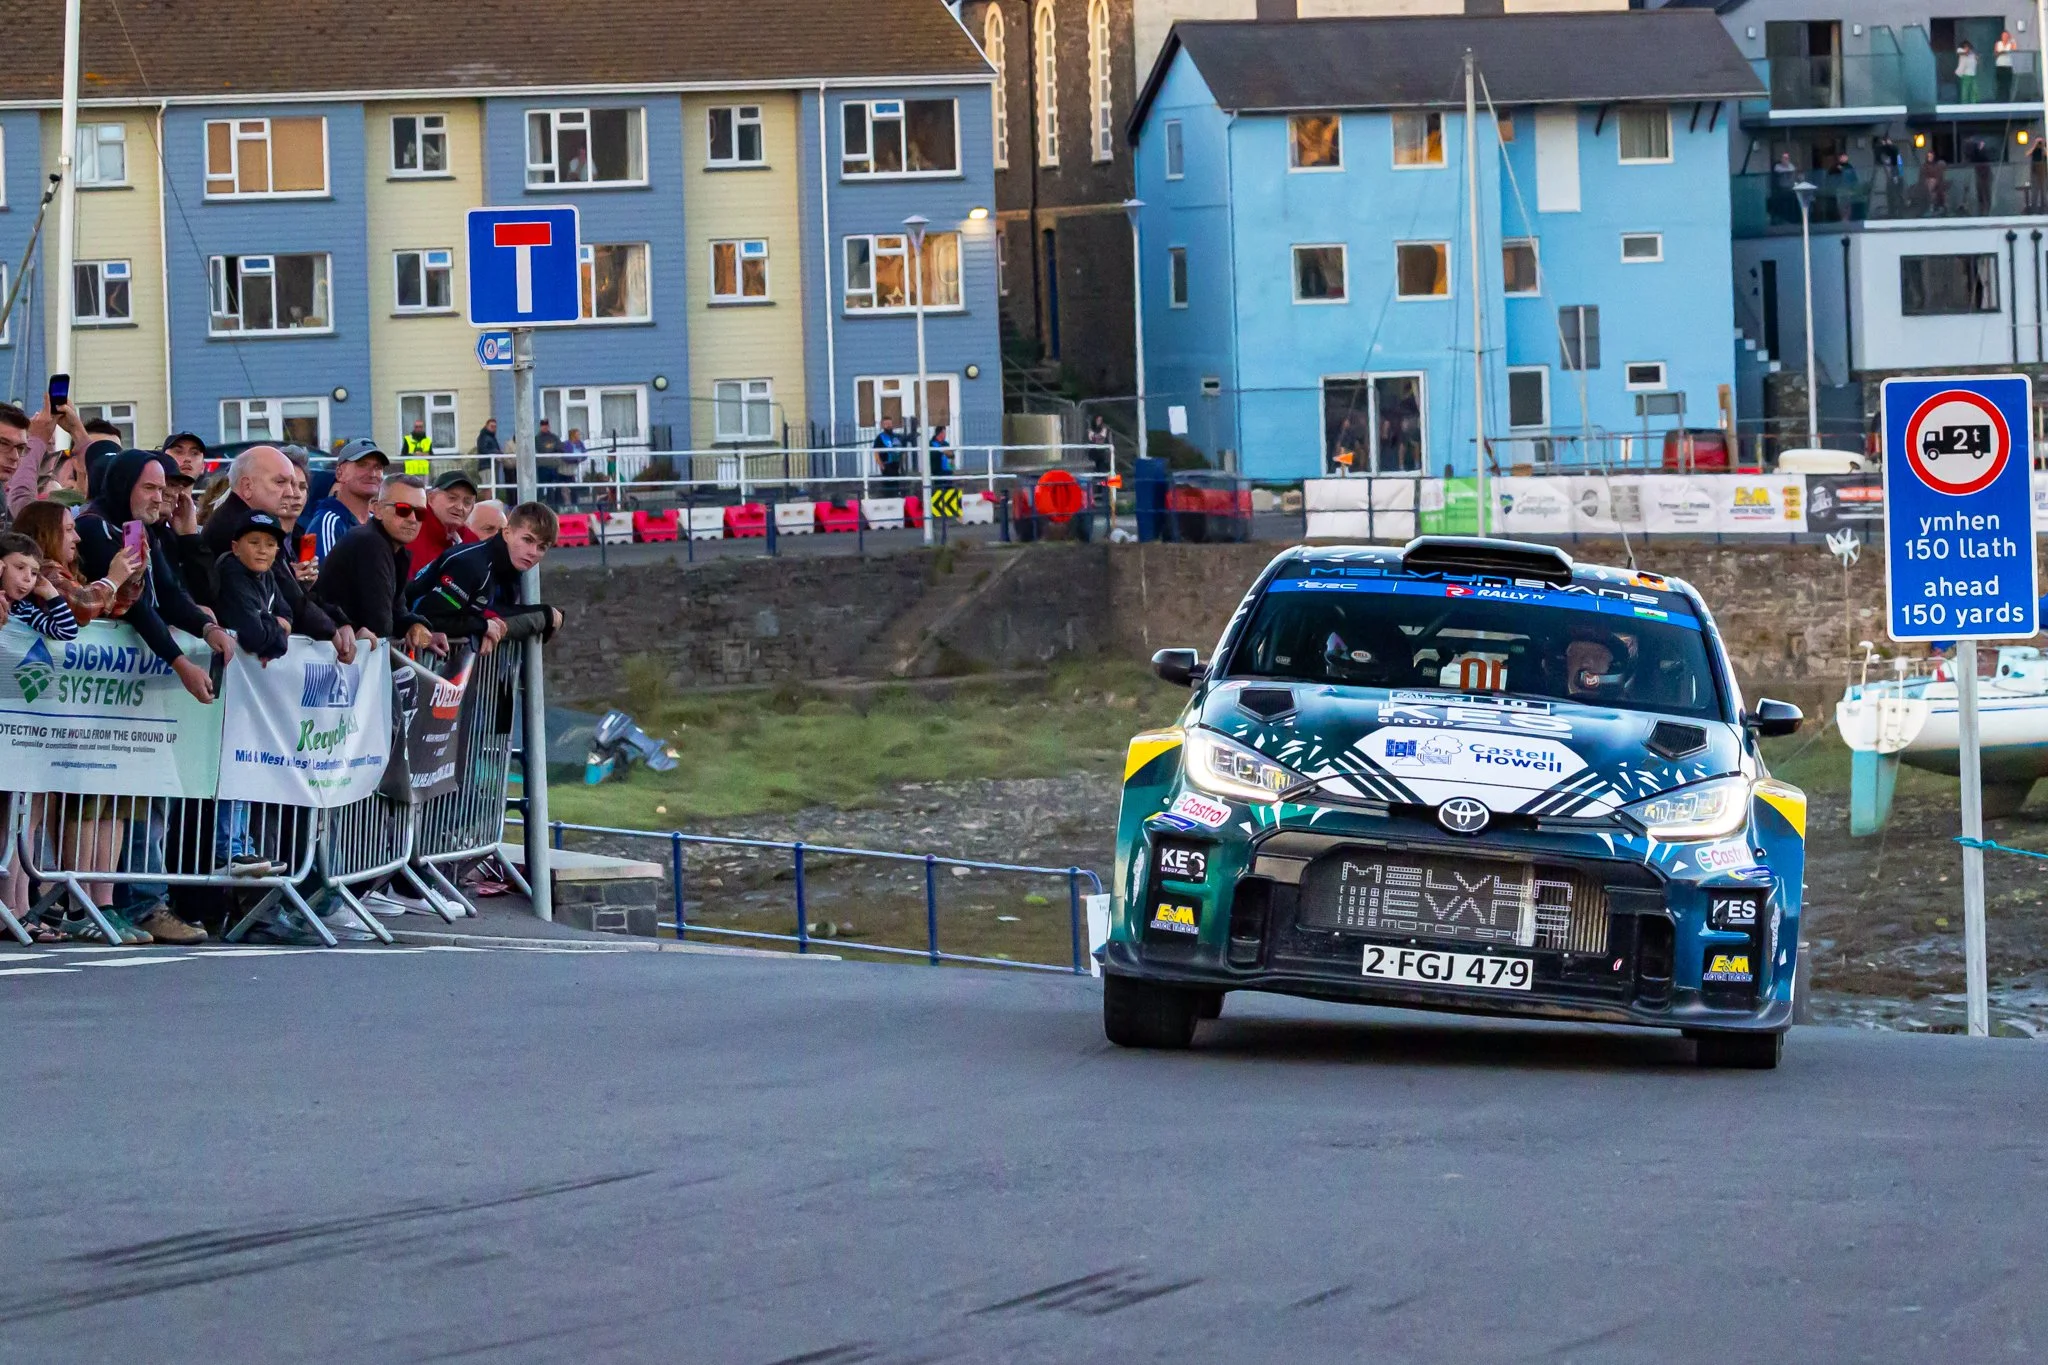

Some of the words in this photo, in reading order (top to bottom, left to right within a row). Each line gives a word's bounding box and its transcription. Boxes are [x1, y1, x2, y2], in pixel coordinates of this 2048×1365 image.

[1919, 511, 2000, 536] ymhen
[1905, 538, 1949, 560] 150
[1959, 537, 2016, 558] llath
[1477, 589, 1529, 600] RALLY
[1515, 578, 1659, 605] EVANS
[1924, 575, 1999, 597] ahead
[1902, 603, 1946, 625] 150
[1956, 602, 2024, 628] yards
[57, 674, 146, 707] SYSTEMS
[1378, 702, 1573, 732] KES
[1378, 716, 1454, 727] GROUP
[51, 727, 68, 739] THE
[67, 728, 91, 740] WORLD
[92, 729, 112, 741] FROM
[113, 730, 129, 741] THE
[131, 731, 164, 743] GROUND
[166, 733, 177, 744] UP
[260, 751, 285, 766] West
[1469, 743, 1555, 762] Castell
[1475, 753, 1562, 773] Howell
[1182, 798, 1227, 824] Castrol
[1157, 903, 1195, 925] E&M
[1465, 958, 1529, 987] 479
[1710, 955, 1749, 973] E&M
